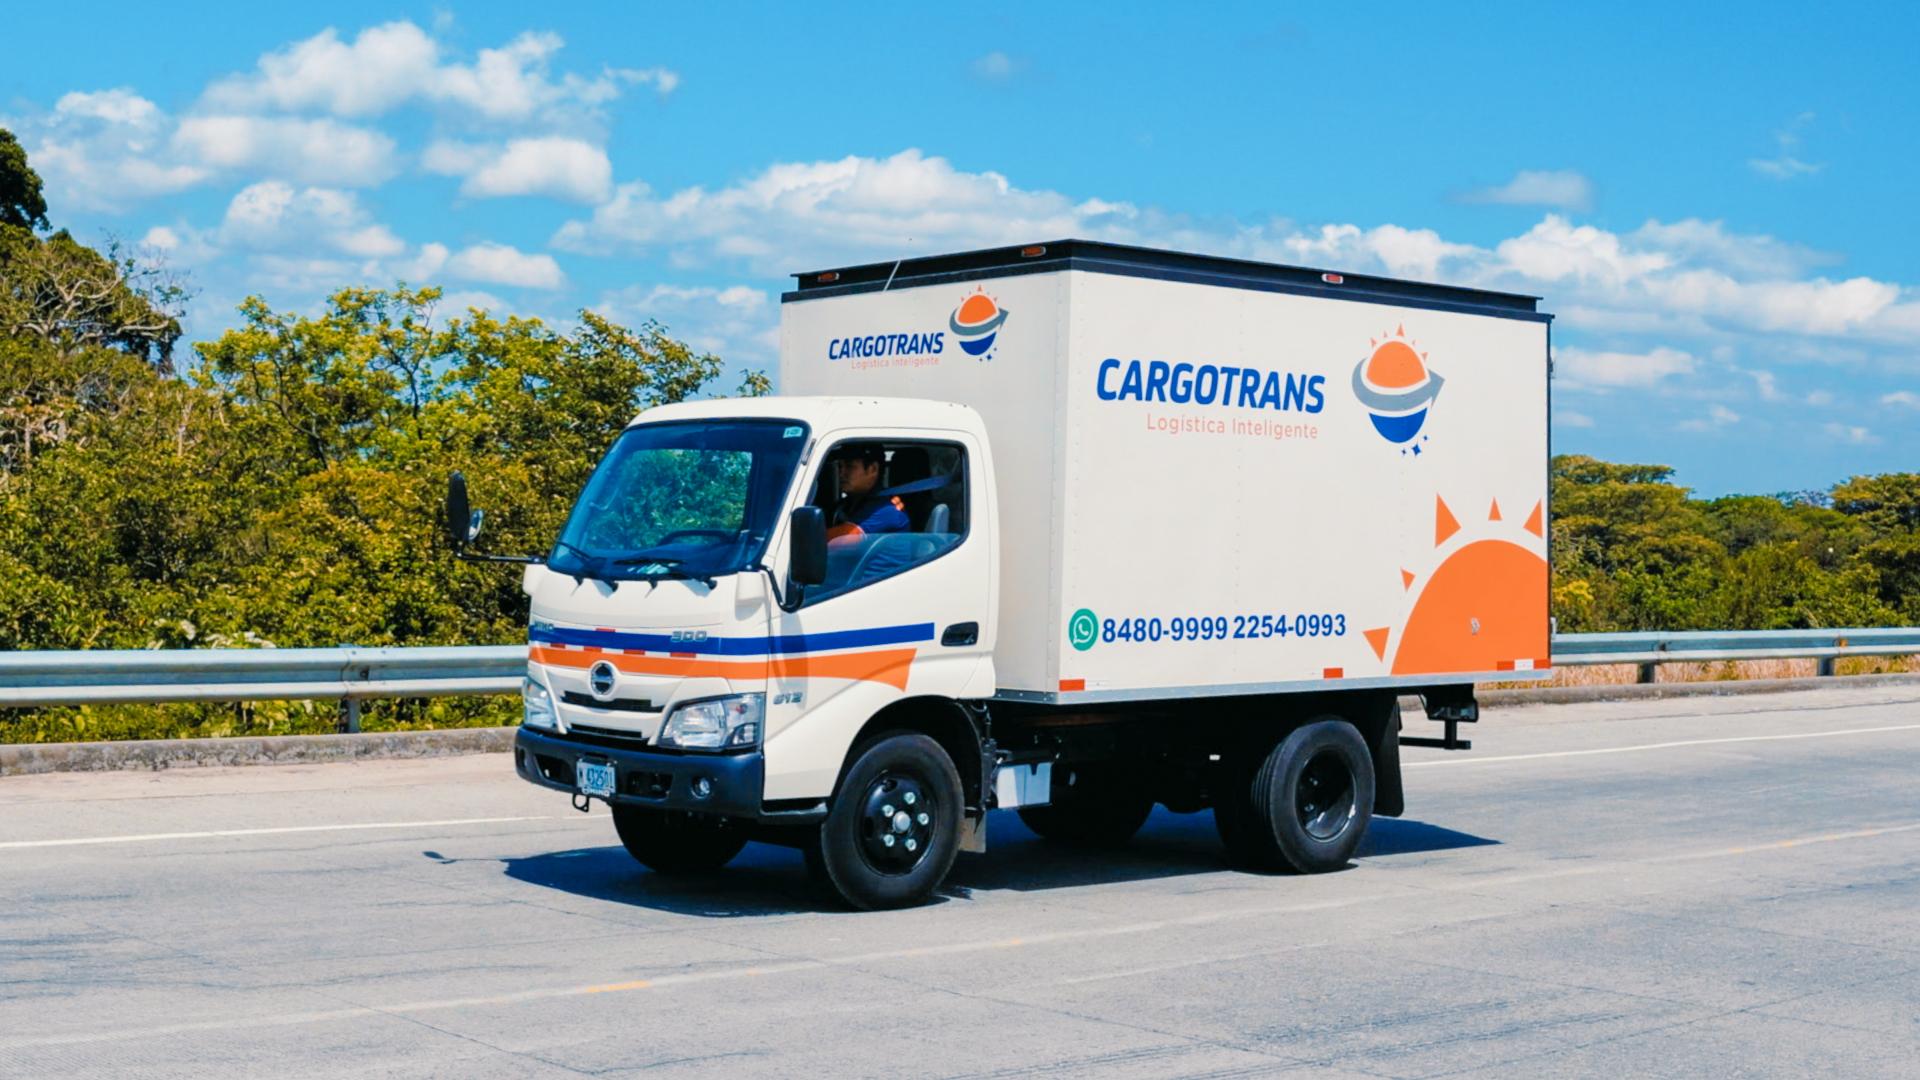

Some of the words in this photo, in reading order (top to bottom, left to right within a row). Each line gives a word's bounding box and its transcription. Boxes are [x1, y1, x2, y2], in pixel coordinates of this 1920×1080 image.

[828, 332, 945, 360] CARGOTRANS
[1096, 358, 1326, 414] CARGOTRANS
[1232, 417, 1319, 440] Inteligente
[671, 630, 708, 642] 300
[1101, 616, 1229, 643] 8480-9999
[1232, 613, 1347, 639] 2254-0993
